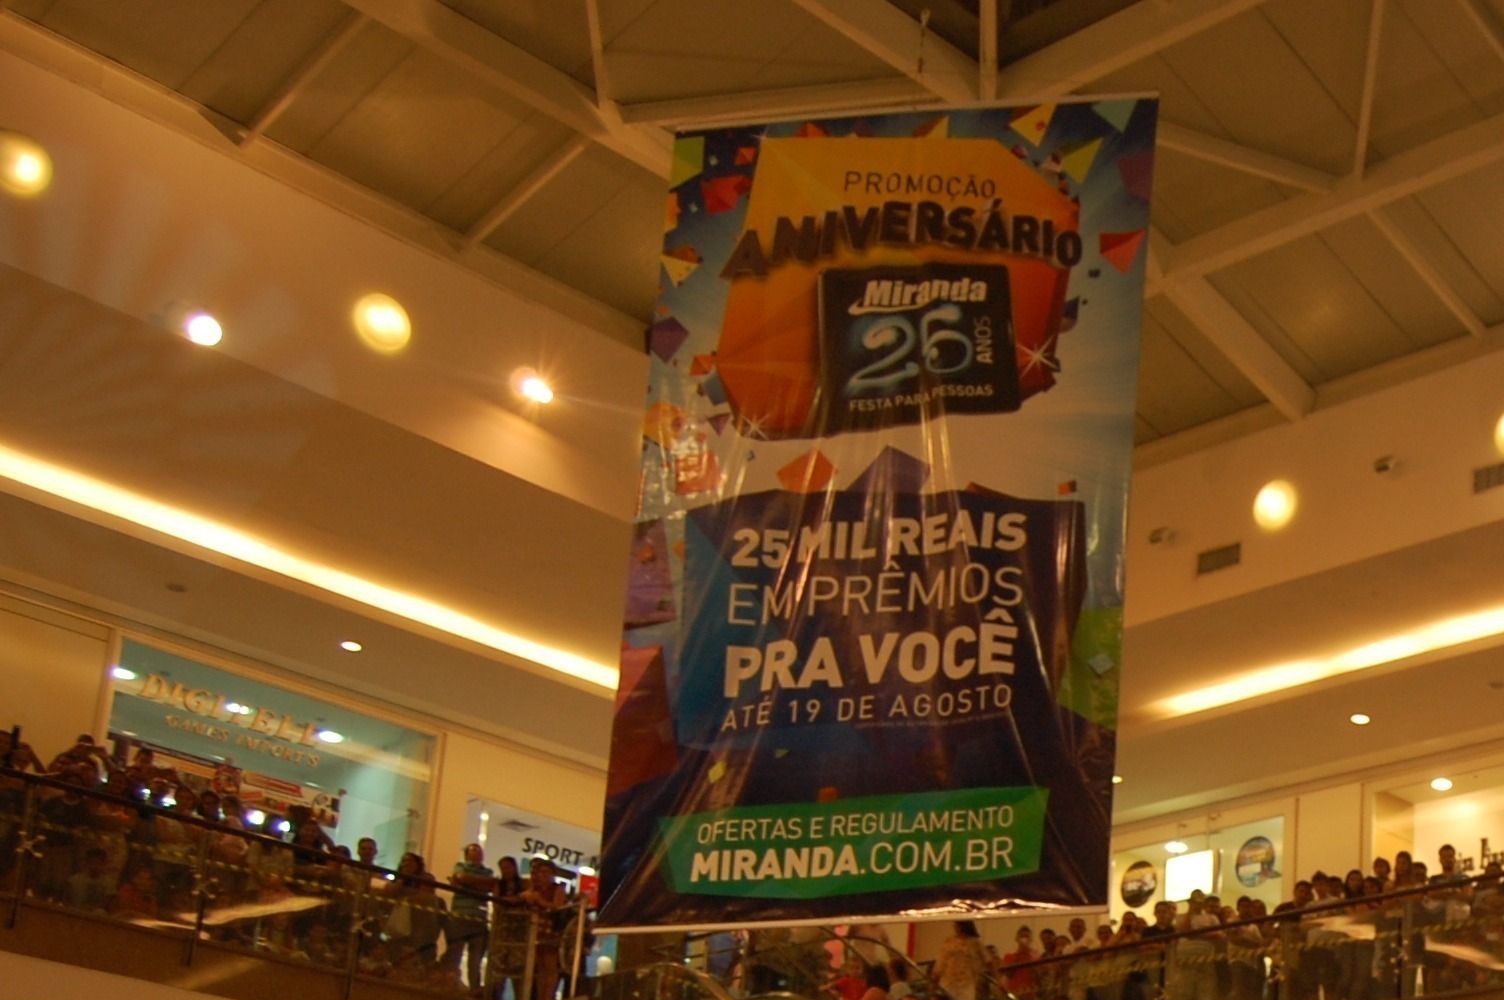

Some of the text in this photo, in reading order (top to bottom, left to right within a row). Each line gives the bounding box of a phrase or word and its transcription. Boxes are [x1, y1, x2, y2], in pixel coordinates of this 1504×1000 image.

[844, 171, 996, 198] PROMOÇÃO
[719, 199, 1082, 280] ANIVERSÁRIO
[861, 277, 988, 308] Miranda
[974, 316, 993, 364] ANOS
[850, 398, 893, 412] FESTA
[932, 384, 994, 399] PESSOAS
[731, 509, 1028, 569] 25 MIL REAIS
[727, 561, 1024, 626] EM PRÊMIOS
[724, 607, 1019, 698] PRA VOCÊ
[165, 714, 230, 742] GAMES
[721, 696, 772, 732] ATÉ
[789, 699, 821, 723] 19
[837, 695, 874, 722] DE
[888, 684, 1012, 717] AGOSTO
[698, 805, 1014, 844] OFERTAS E REGULAMENTO
[522, 837, 584, 866] SPORT
[690, 836, 1014, 883] MIRANDA.COM.BR
